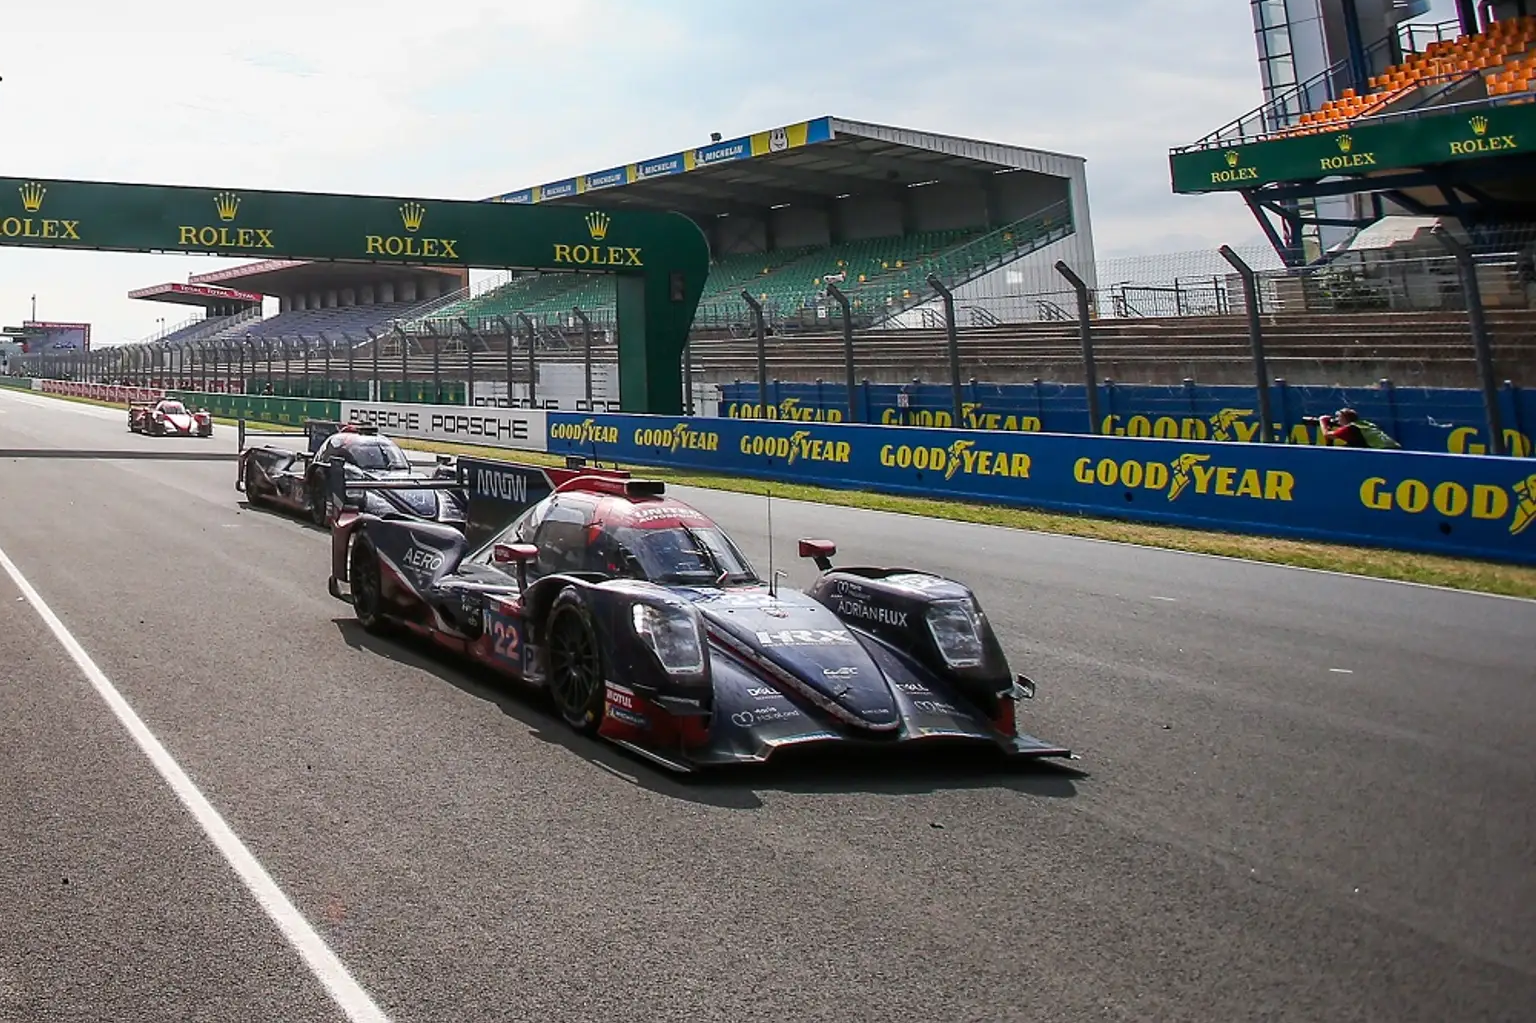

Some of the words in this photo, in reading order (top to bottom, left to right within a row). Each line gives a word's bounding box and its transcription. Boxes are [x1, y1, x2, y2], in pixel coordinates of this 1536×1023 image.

[706, 144, 744, 162] MICHELIN
[1450, 135, 1517, 155] ROLEX
[1321, 153, 1376, 170] ROLEX
[1211, 167, 1258, 183] ROLEX
[178, 226, 275, 248] ROLEX
[366, 236, 459, 259] ROLEX
[553, 244, 644, 266] ROLEX
[432, 415, 528, 440] PORSCHE
[551, 420, 618, 443] GOODYEAR
[634, 424, 718, 452] GOODYEAR
[740, 432, 850, 464] GOODYEAR
[880, 442, 1031, 479] GOODYEAR
[1073, 454, 1295, 501] GOODYEAR
[402, 547, 444, 571] AERO
[495, 621, 520, 661] 22
[755, 630, 856, 644] HRX
[606, 688, 633, 709] MOTUL
